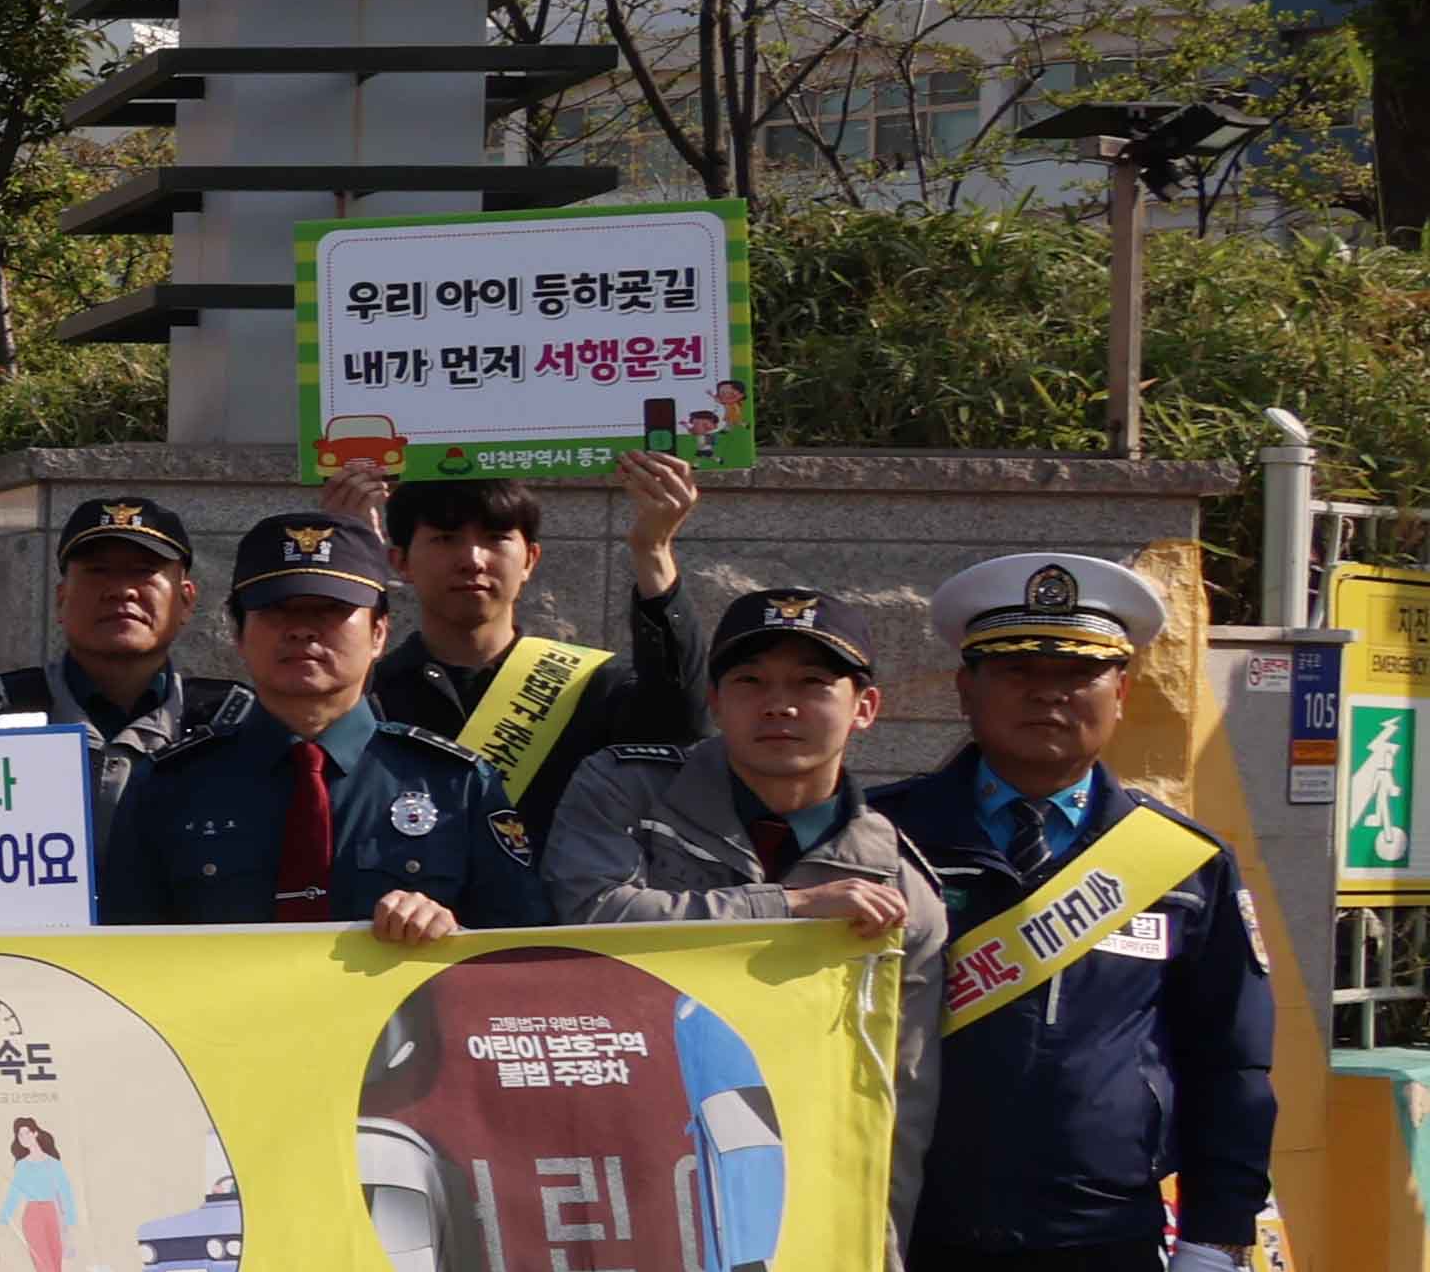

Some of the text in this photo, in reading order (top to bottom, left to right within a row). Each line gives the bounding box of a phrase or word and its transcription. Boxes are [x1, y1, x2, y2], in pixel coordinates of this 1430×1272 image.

[345, 267, 697, 319] 우리 아이 등하굣길
[343, 335, 707, 386] 내가 먼저 서행운전
[477, 447, 612, 470] 인천광역시 동구
[510, 646, 582, 723] 교통법규
[1304, 692, 1336, 729] 105
[1020, 869, 1123, 960] 속도는
[468, 1032, 648, 1060] 어린이 보호구역
[498, 1059, 629, 1088] 불법 주정차
